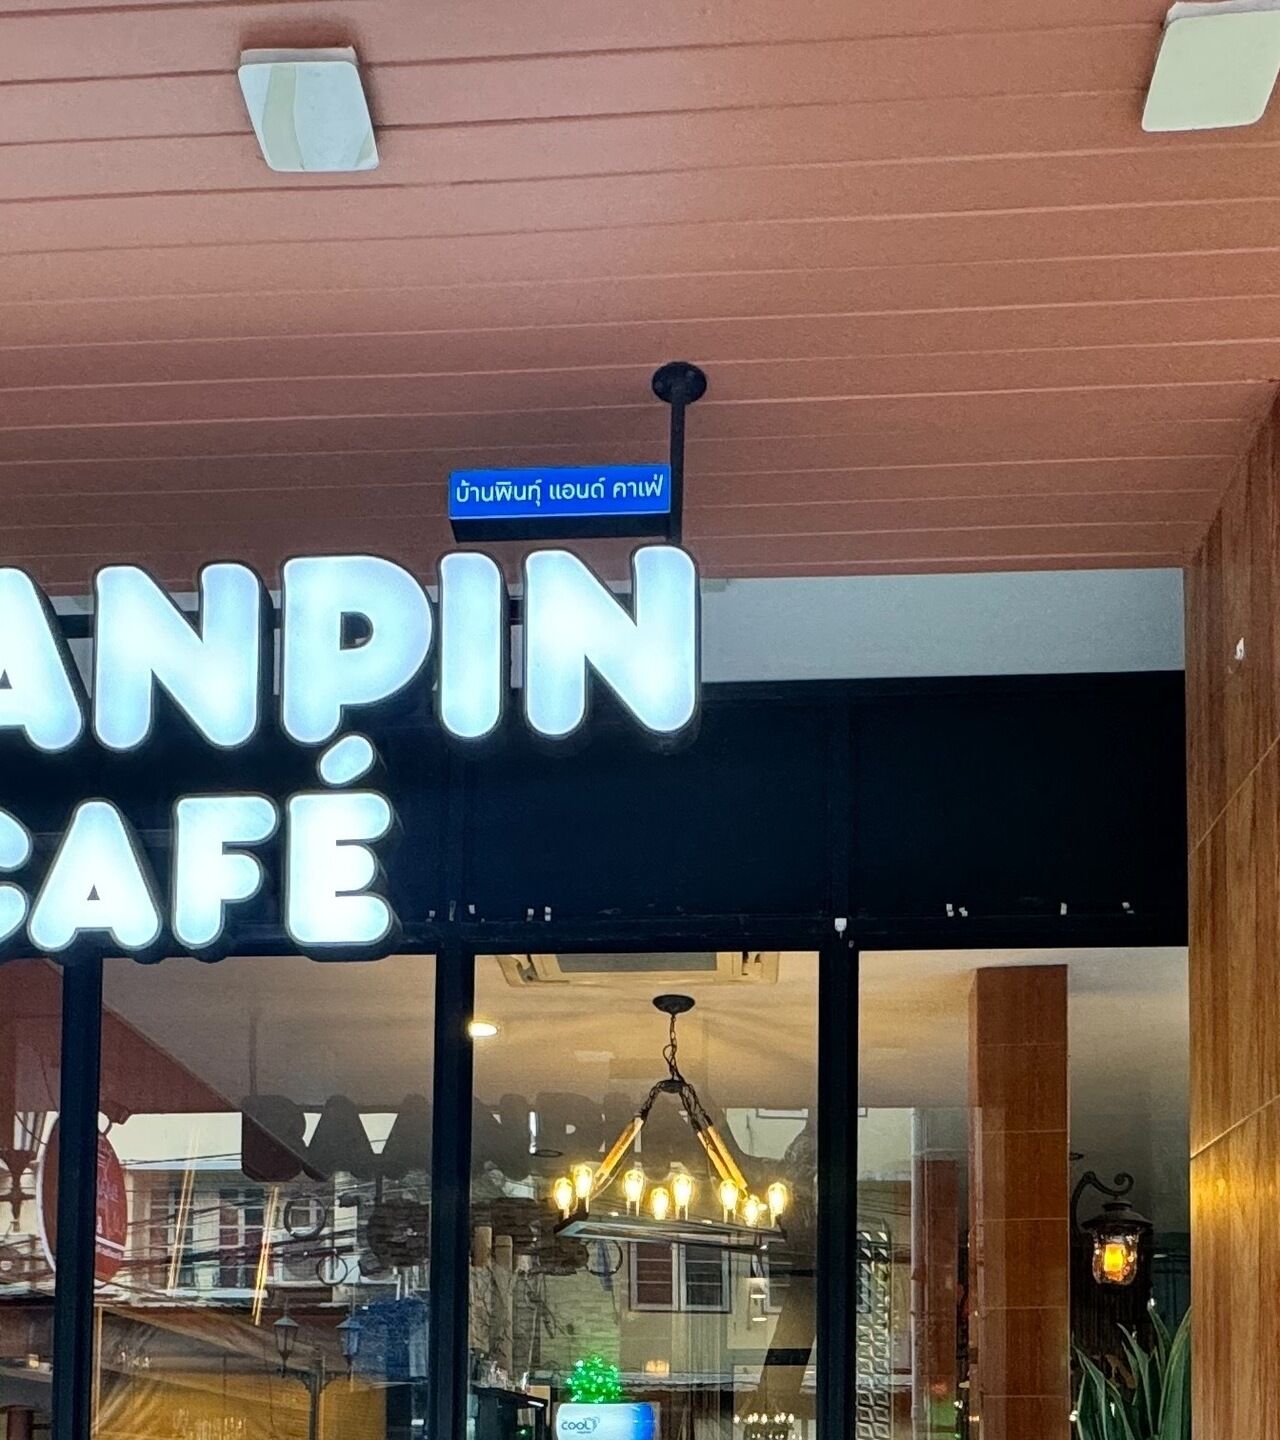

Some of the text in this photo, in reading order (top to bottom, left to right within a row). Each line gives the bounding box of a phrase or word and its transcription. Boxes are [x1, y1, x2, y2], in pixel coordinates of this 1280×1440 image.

[455, 473, 664, 507] บ้านพินทุ์ แอนด์ คาเฟ่
